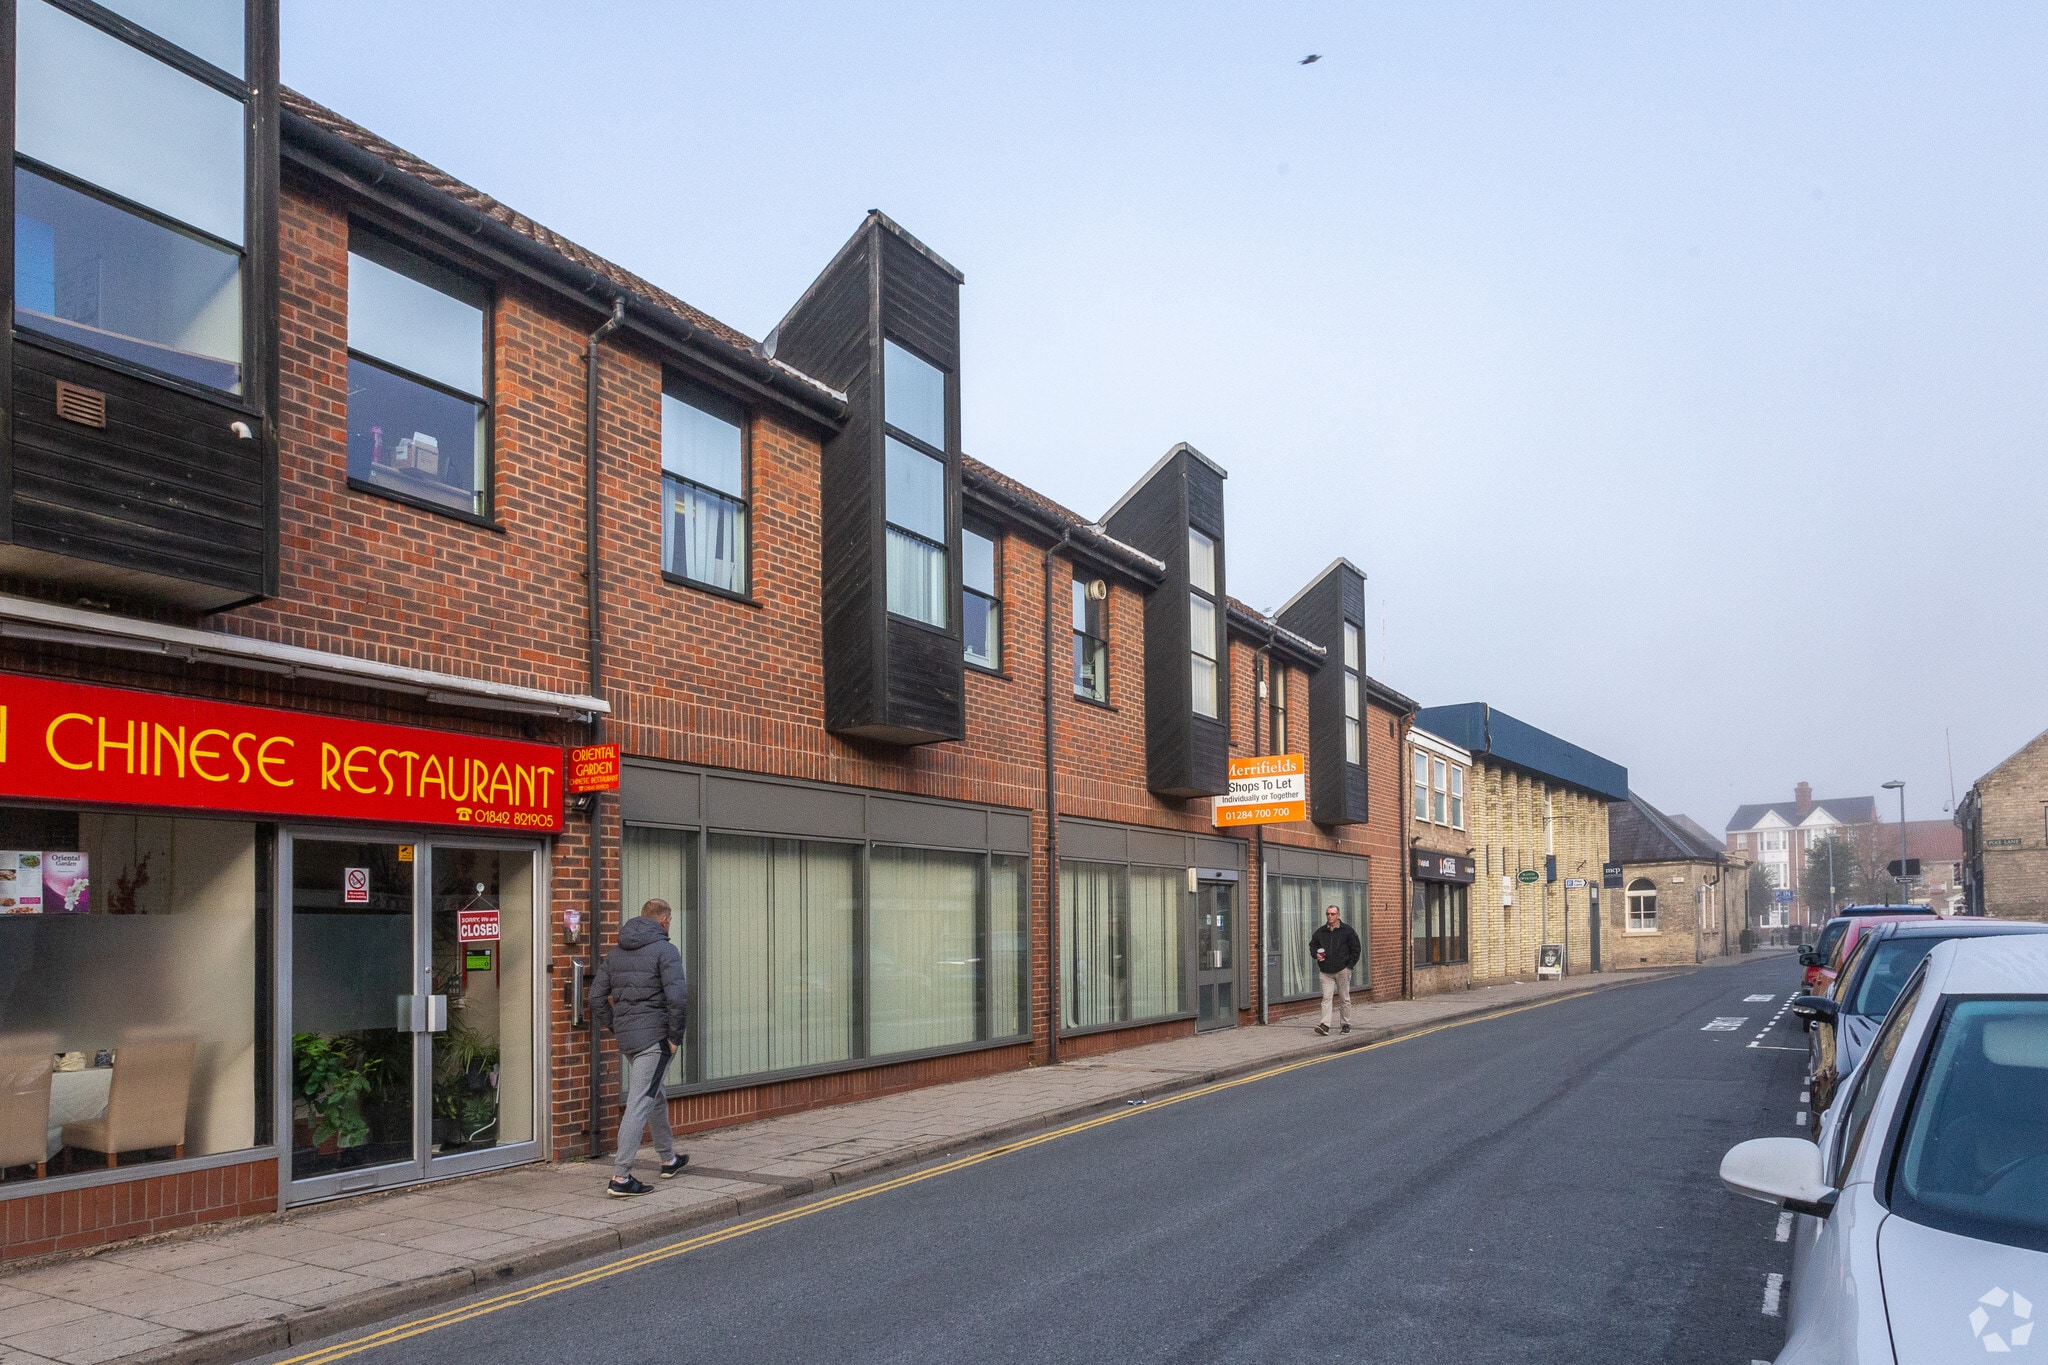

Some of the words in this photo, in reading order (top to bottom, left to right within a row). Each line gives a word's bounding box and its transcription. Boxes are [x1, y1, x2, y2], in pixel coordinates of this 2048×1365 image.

[46, 712, 295, 787] CHINESE
[321, 742, 555, 808] RESTAURANT
[572, 746, 616, 762] ORIENTAL
[576, 761, 612, 776] GARDEN
[1229, 781, 1259, 793] Shops
[1262, 780, 1273, 790] To
[1276, 778, 1292, 789] Let
[1223, 794, 1259, 803] Individually
[1270, 791, 1298, 800] Together
[475, 809, 510, 824] 01842
[514, 812, 554, 828] 821905
[1225, 810, 1253, 820] 01284
[1255, 809, 1271, 818] 700
[1273, 807, 1289, 816] 700
[461, 924, 499, 937] CLOSED
